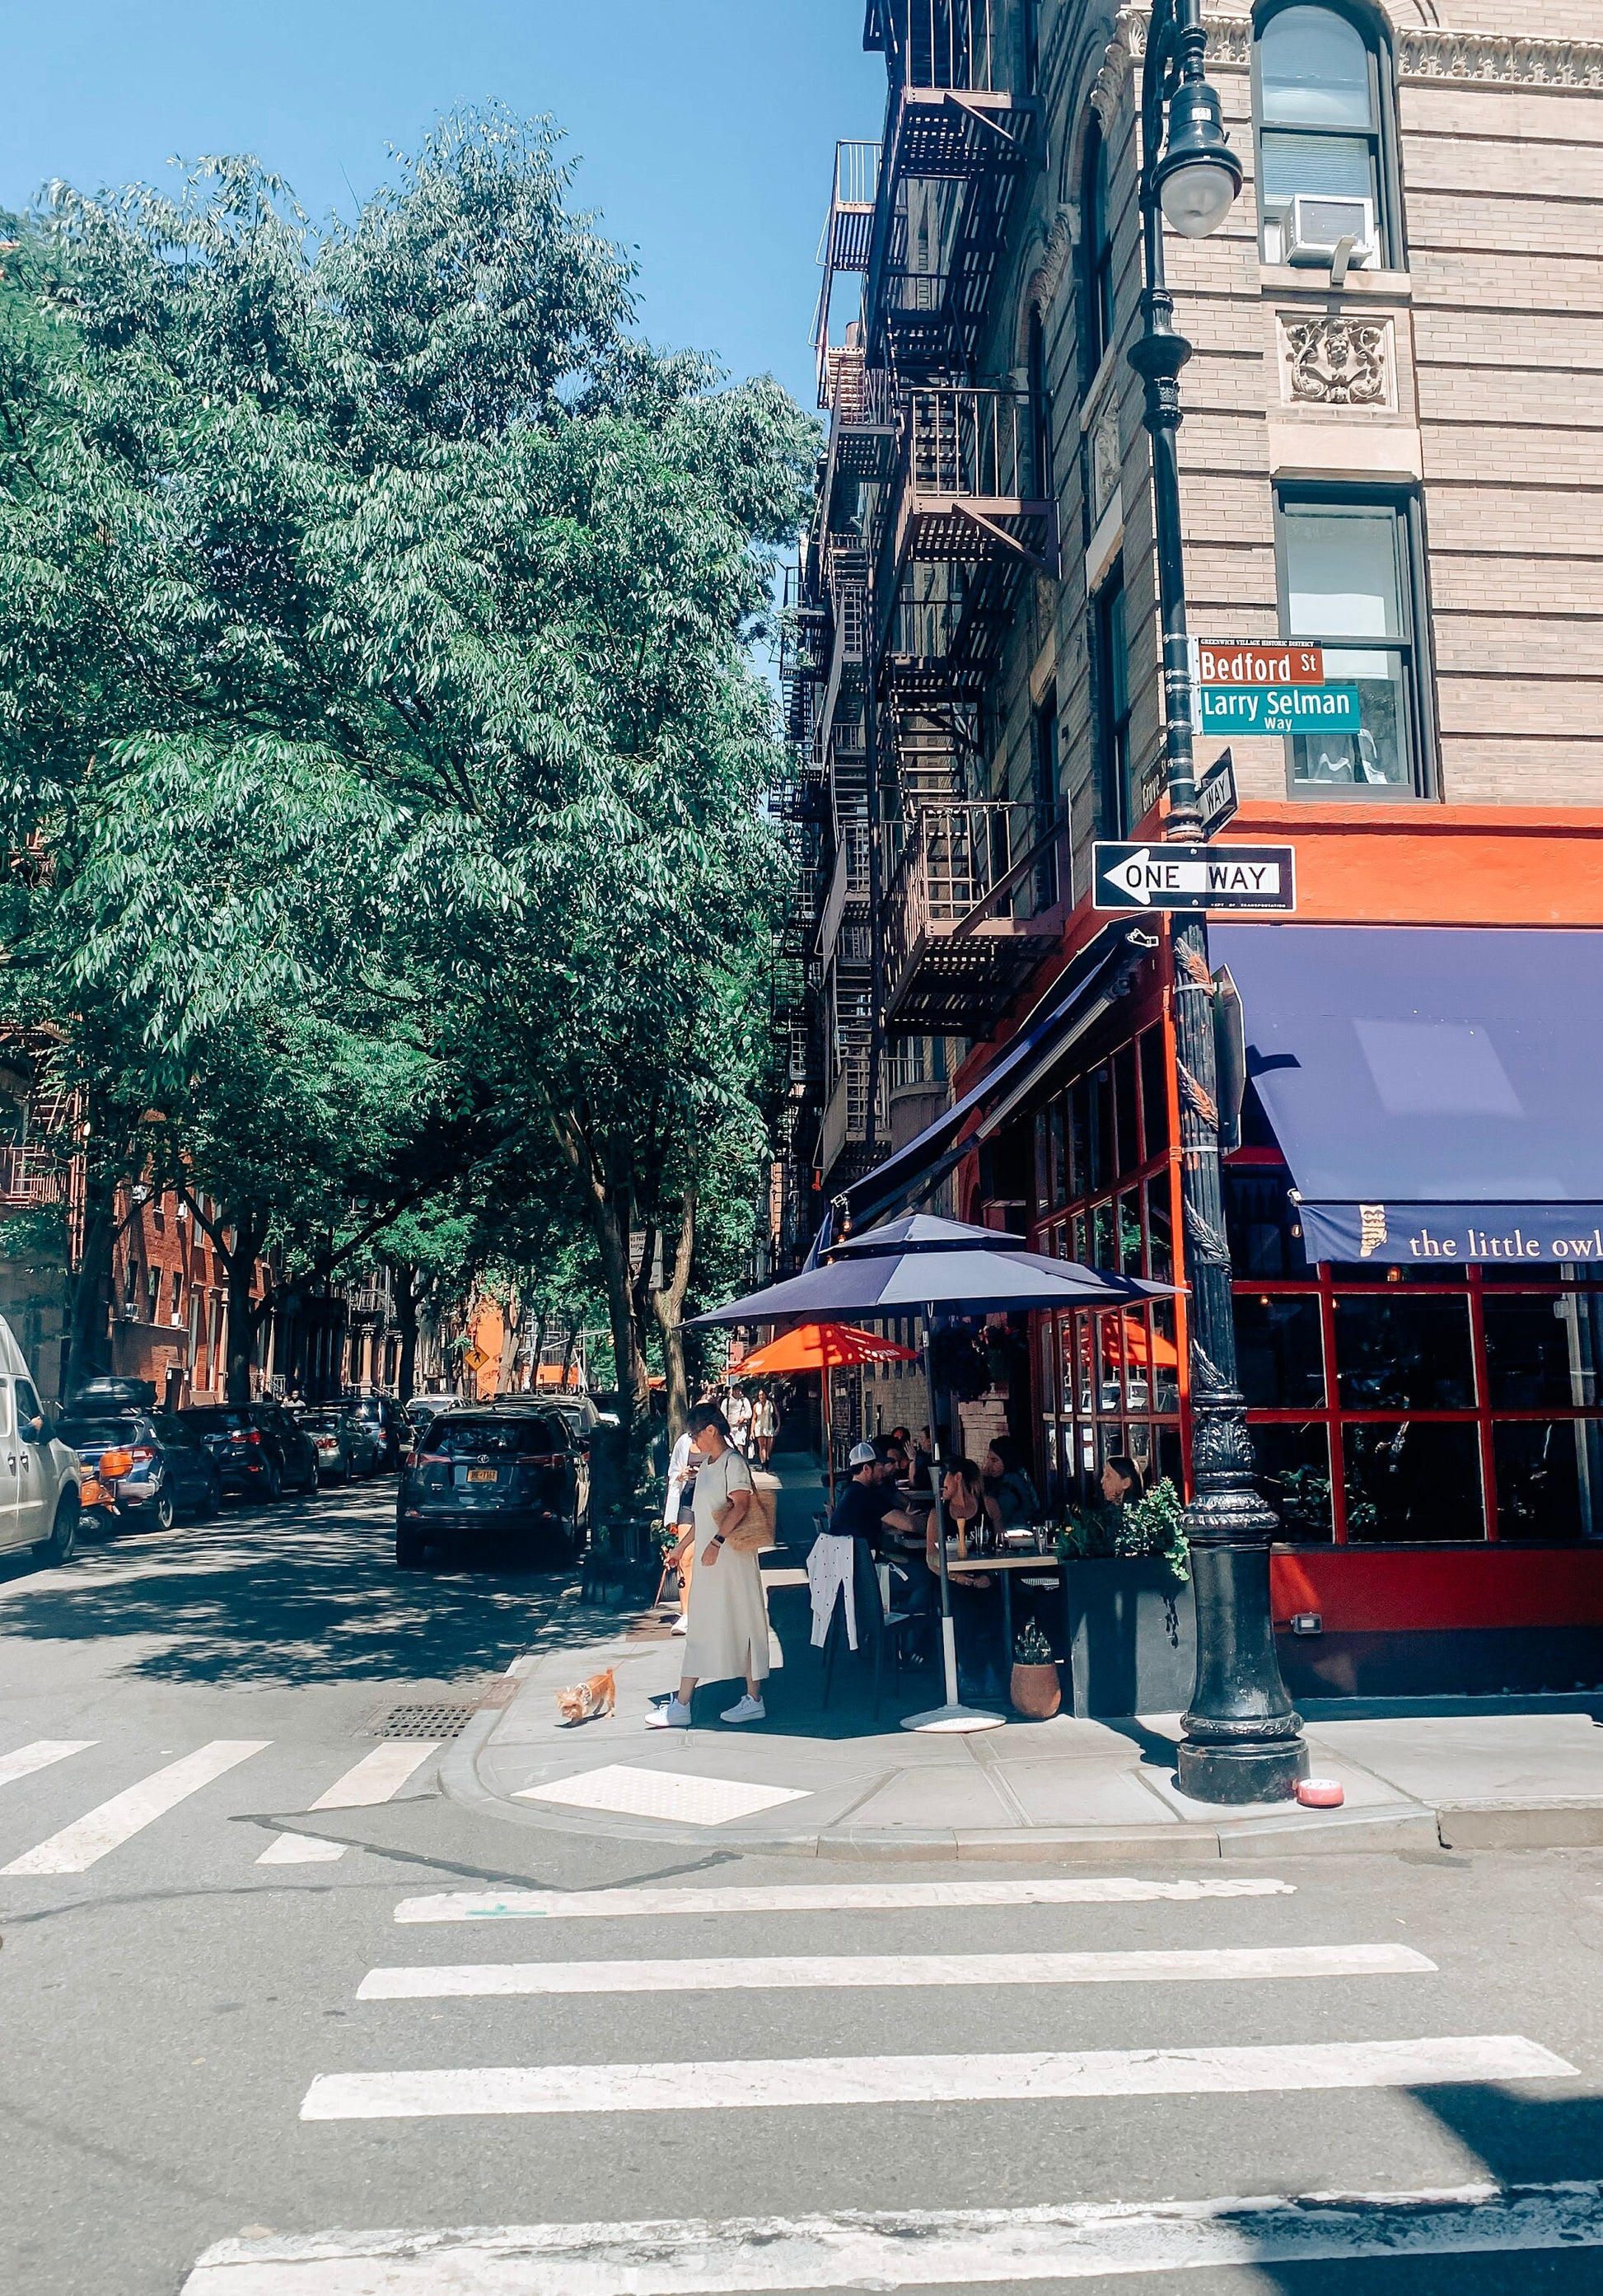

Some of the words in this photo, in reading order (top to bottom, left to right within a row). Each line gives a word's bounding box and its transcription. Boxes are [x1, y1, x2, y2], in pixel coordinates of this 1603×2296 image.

[1201, 651, 1291, 681] Bedford
[1301, 653, 1316, 671] St
[1204, 691, 1259, 722] Larry
[1267, 690, 1350, 715] Selman
[1264, 717, 1292, 732] Way
[1143, 774, 1160, 812] Grove
[1206, 774, 1226, 815] WAY
[1126, 864, 1180, 889] ONE
[1208, 866, 1267, 890] WAY
[1409, 1228, 1457, 1257] the
[1468, 1228, 1540, 1257] little
[1551, 1229, 1603, 1257] owl
